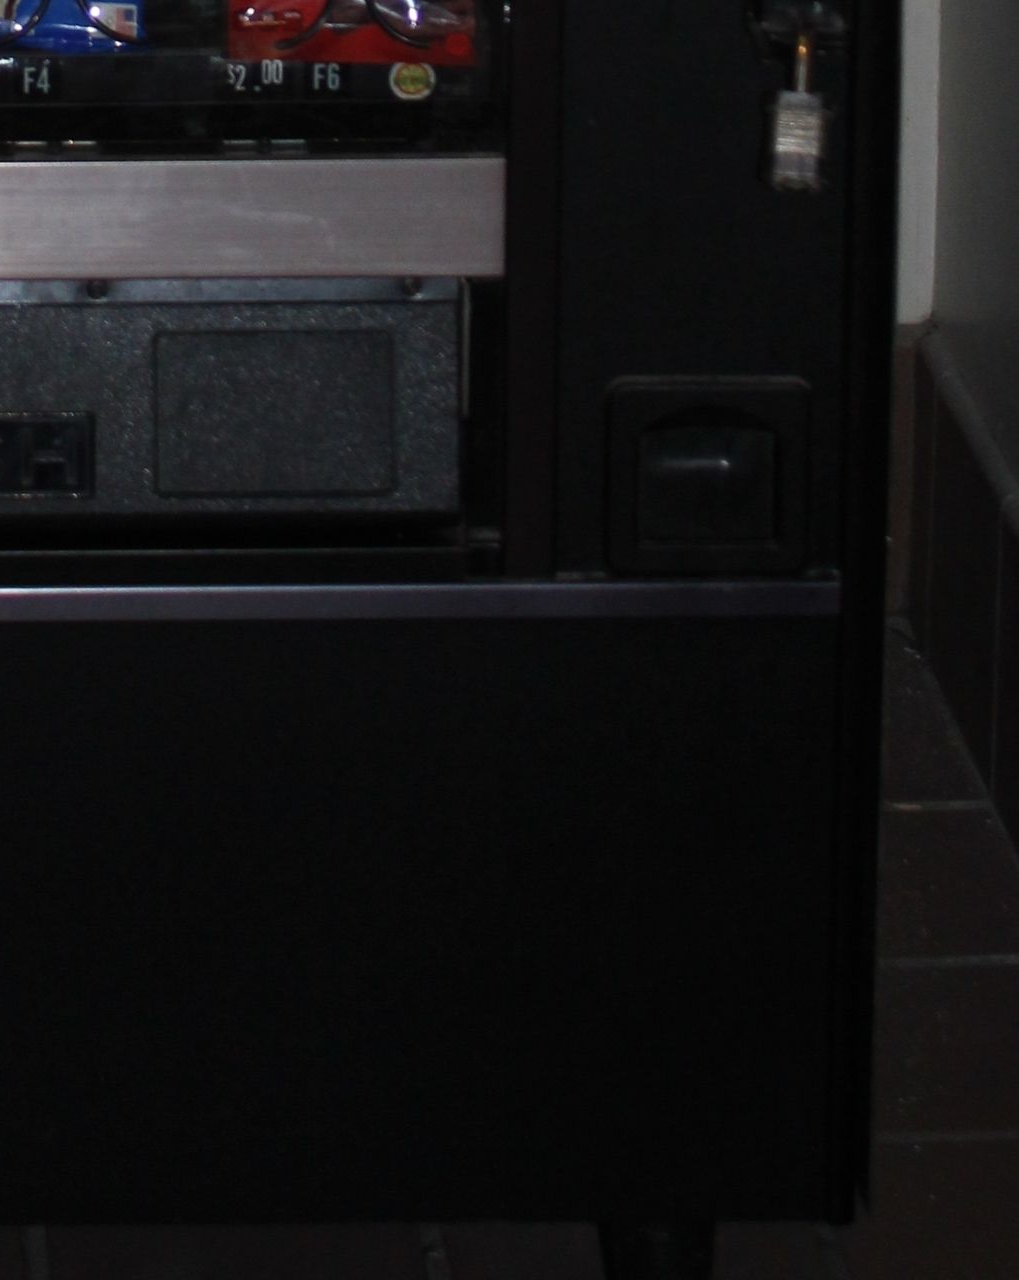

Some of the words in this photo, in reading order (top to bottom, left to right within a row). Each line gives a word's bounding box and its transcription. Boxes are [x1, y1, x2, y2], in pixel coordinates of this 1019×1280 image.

[23, 67, 51, 95] F4
[226, 59, 283, 91] $2.00
[313, 63, 341, 90] F6
